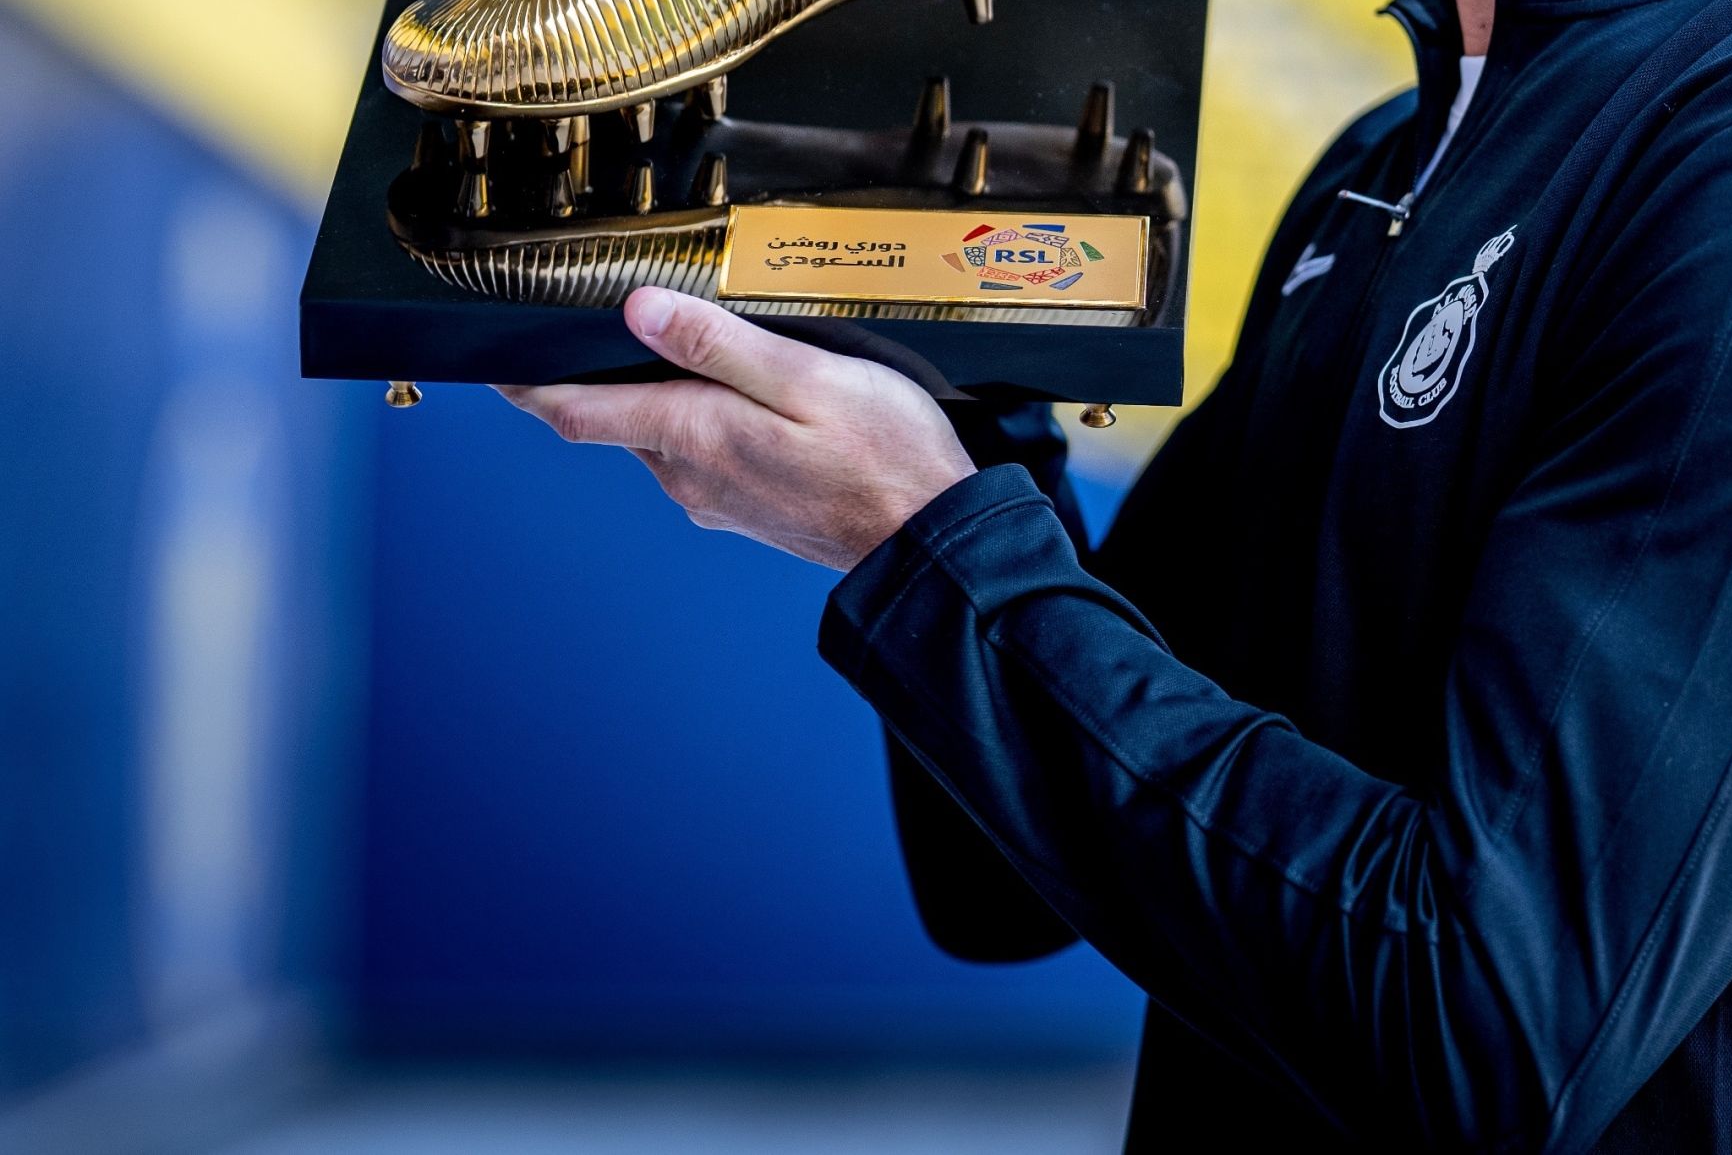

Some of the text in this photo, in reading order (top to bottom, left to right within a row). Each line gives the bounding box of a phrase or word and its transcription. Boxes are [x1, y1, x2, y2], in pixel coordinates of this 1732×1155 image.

[767, 237, 906, 254] دوري روشن
[995, 249, 1054, 264] RSL
[1389, 364, 1448, 409] FOOTBALL CLUB
